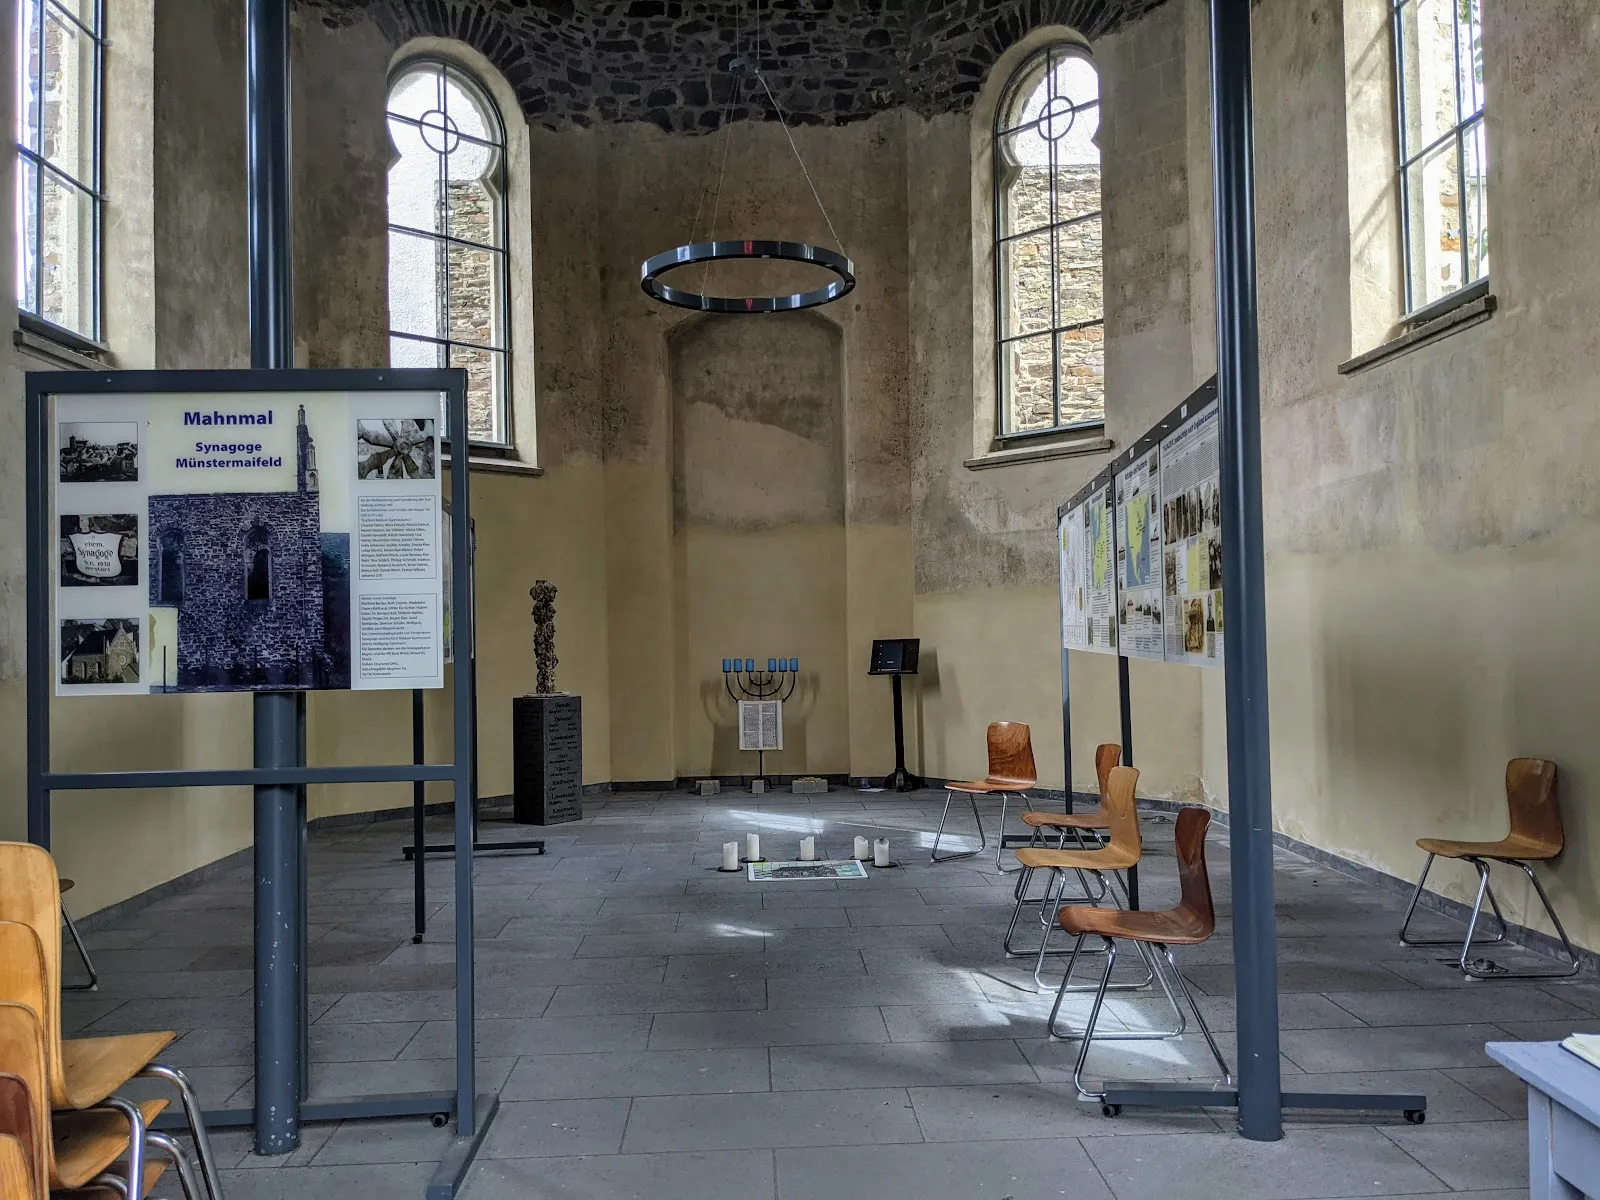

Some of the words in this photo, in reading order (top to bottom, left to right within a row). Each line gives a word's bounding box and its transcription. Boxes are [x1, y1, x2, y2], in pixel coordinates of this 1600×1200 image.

[184, 410, 273, 425] Mahnmal
[195, 442, 263, 455] Synagoge
[176, 456, 282, 468] Münstermaifeld
[78, 547, 114, 560] Synagoge
